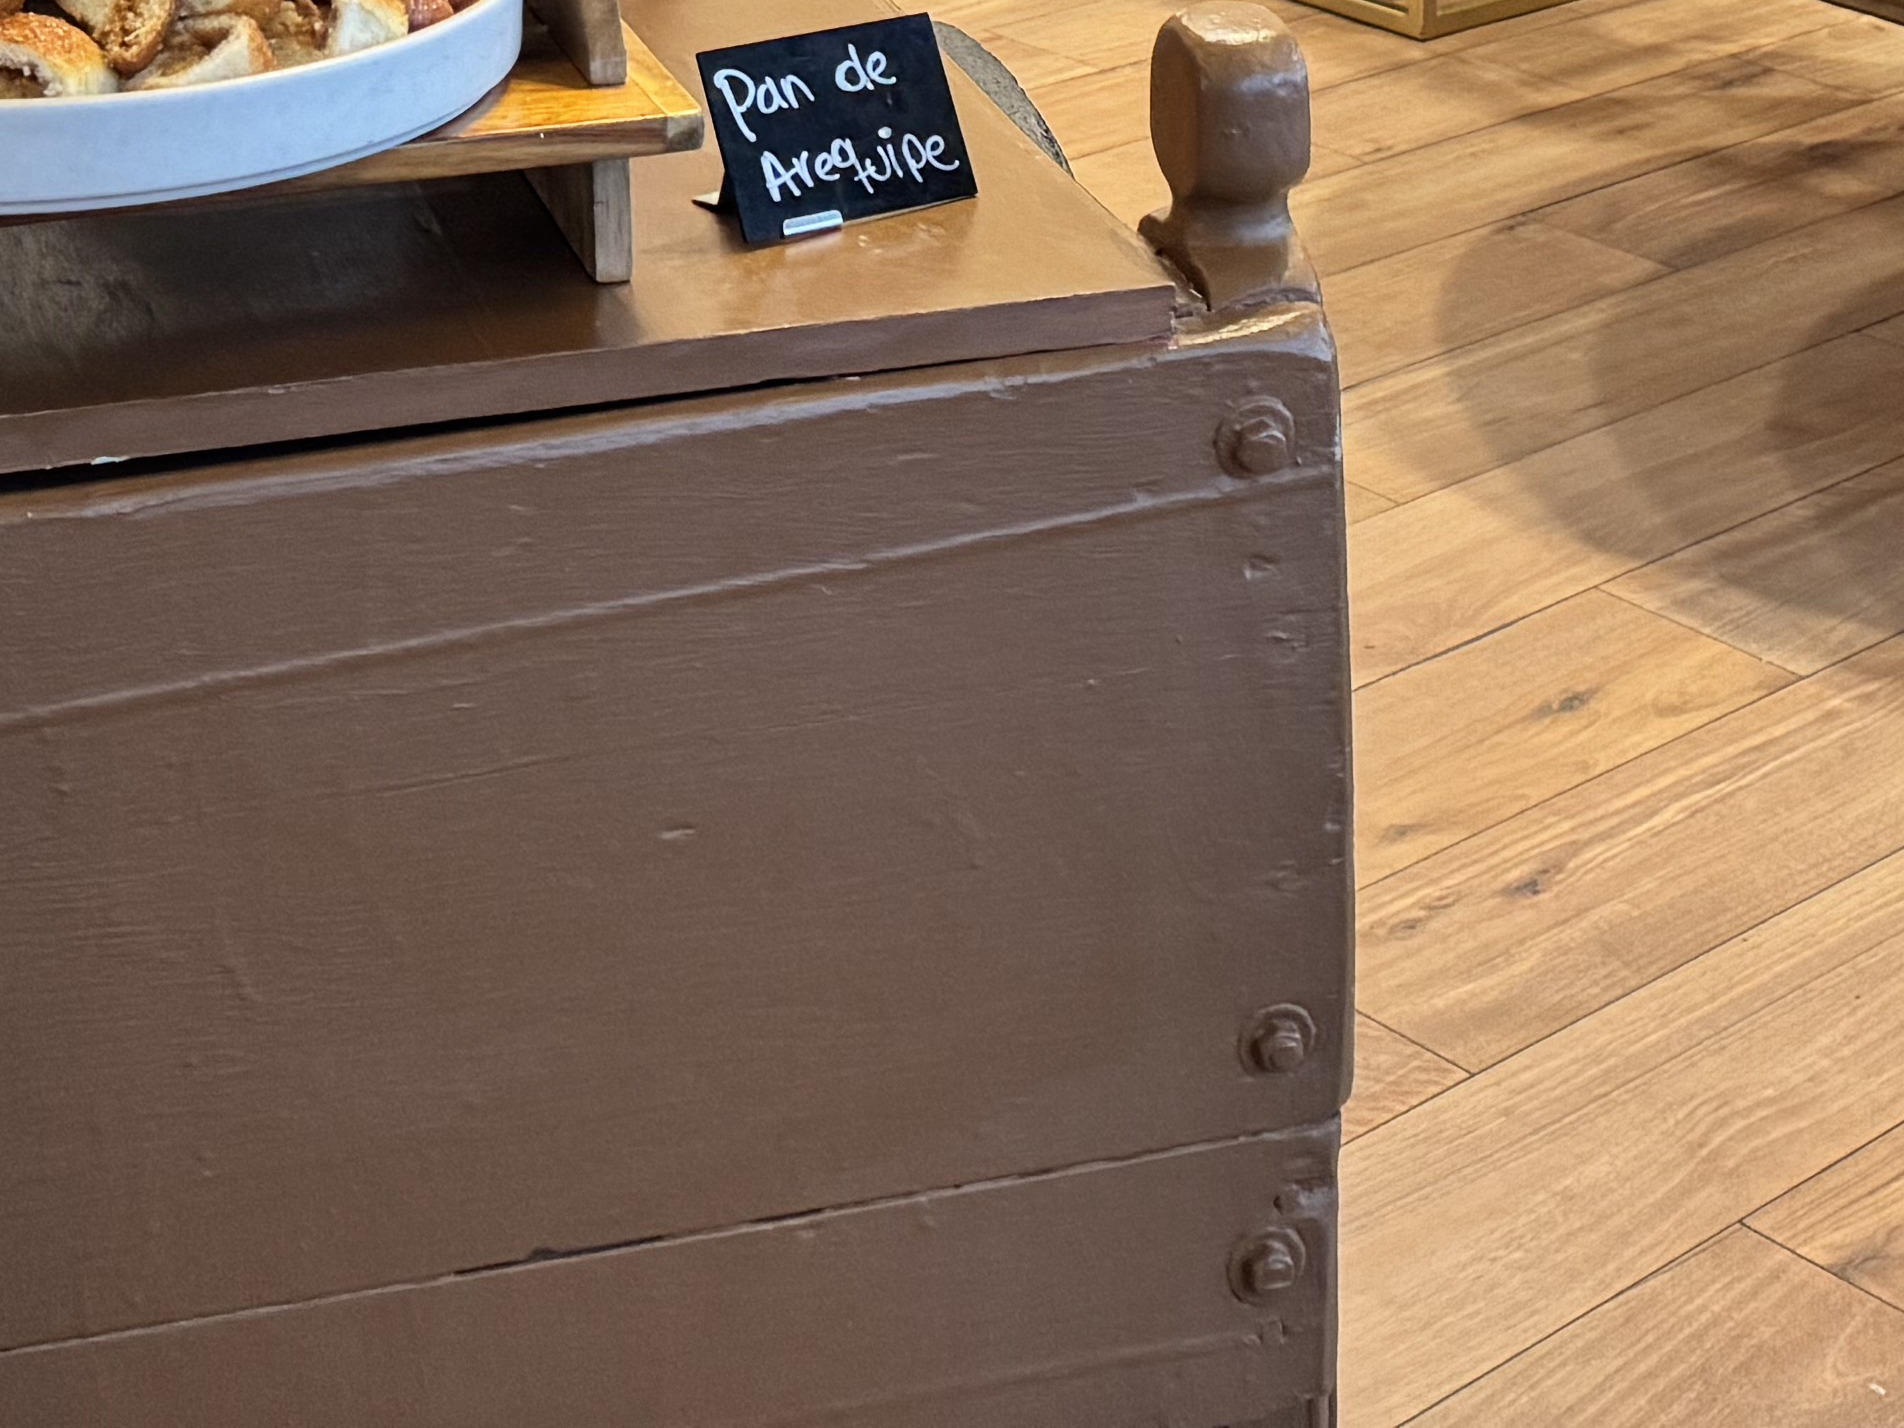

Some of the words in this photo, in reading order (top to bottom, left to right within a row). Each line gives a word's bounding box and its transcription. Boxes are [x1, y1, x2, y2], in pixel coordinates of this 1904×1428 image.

[713, 68, 816, 143] Pan
[834, 43, 897, 93] de
[760, 126, 960, 203] Arequipe
